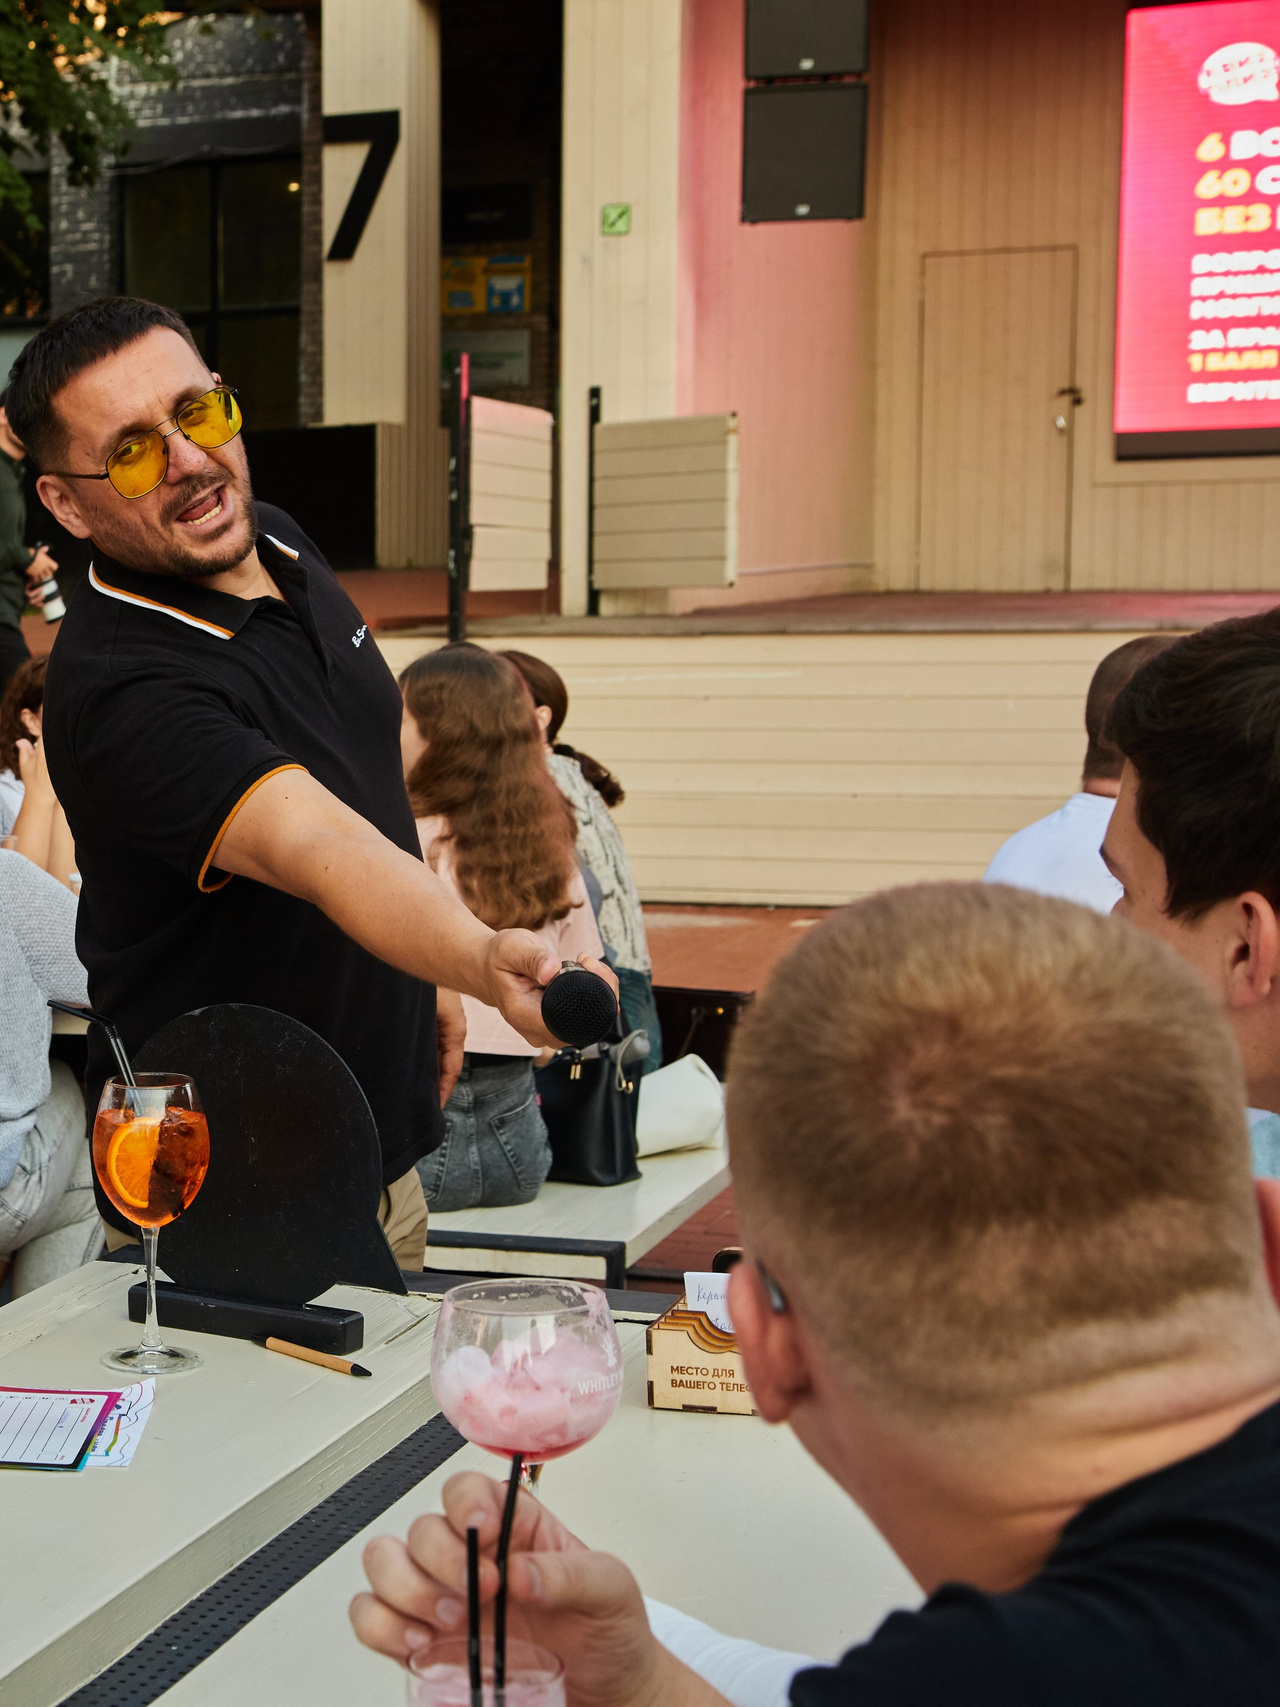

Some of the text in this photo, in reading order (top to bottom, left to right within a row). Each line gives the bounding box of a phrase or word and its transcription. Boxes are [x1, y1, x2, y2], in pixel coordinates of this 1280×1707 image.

[1195, 132, 1226, 162] 6
[322, 110, 400, 261] 7
[1194, 168, 1251, 199] 60
[578, 1373, 619, 1395] WHITLEY
[670, 1365, 735, 1379] МЕСТО ДЛЯ
[670, 1378, 717, 1391] ВАШЕГО
